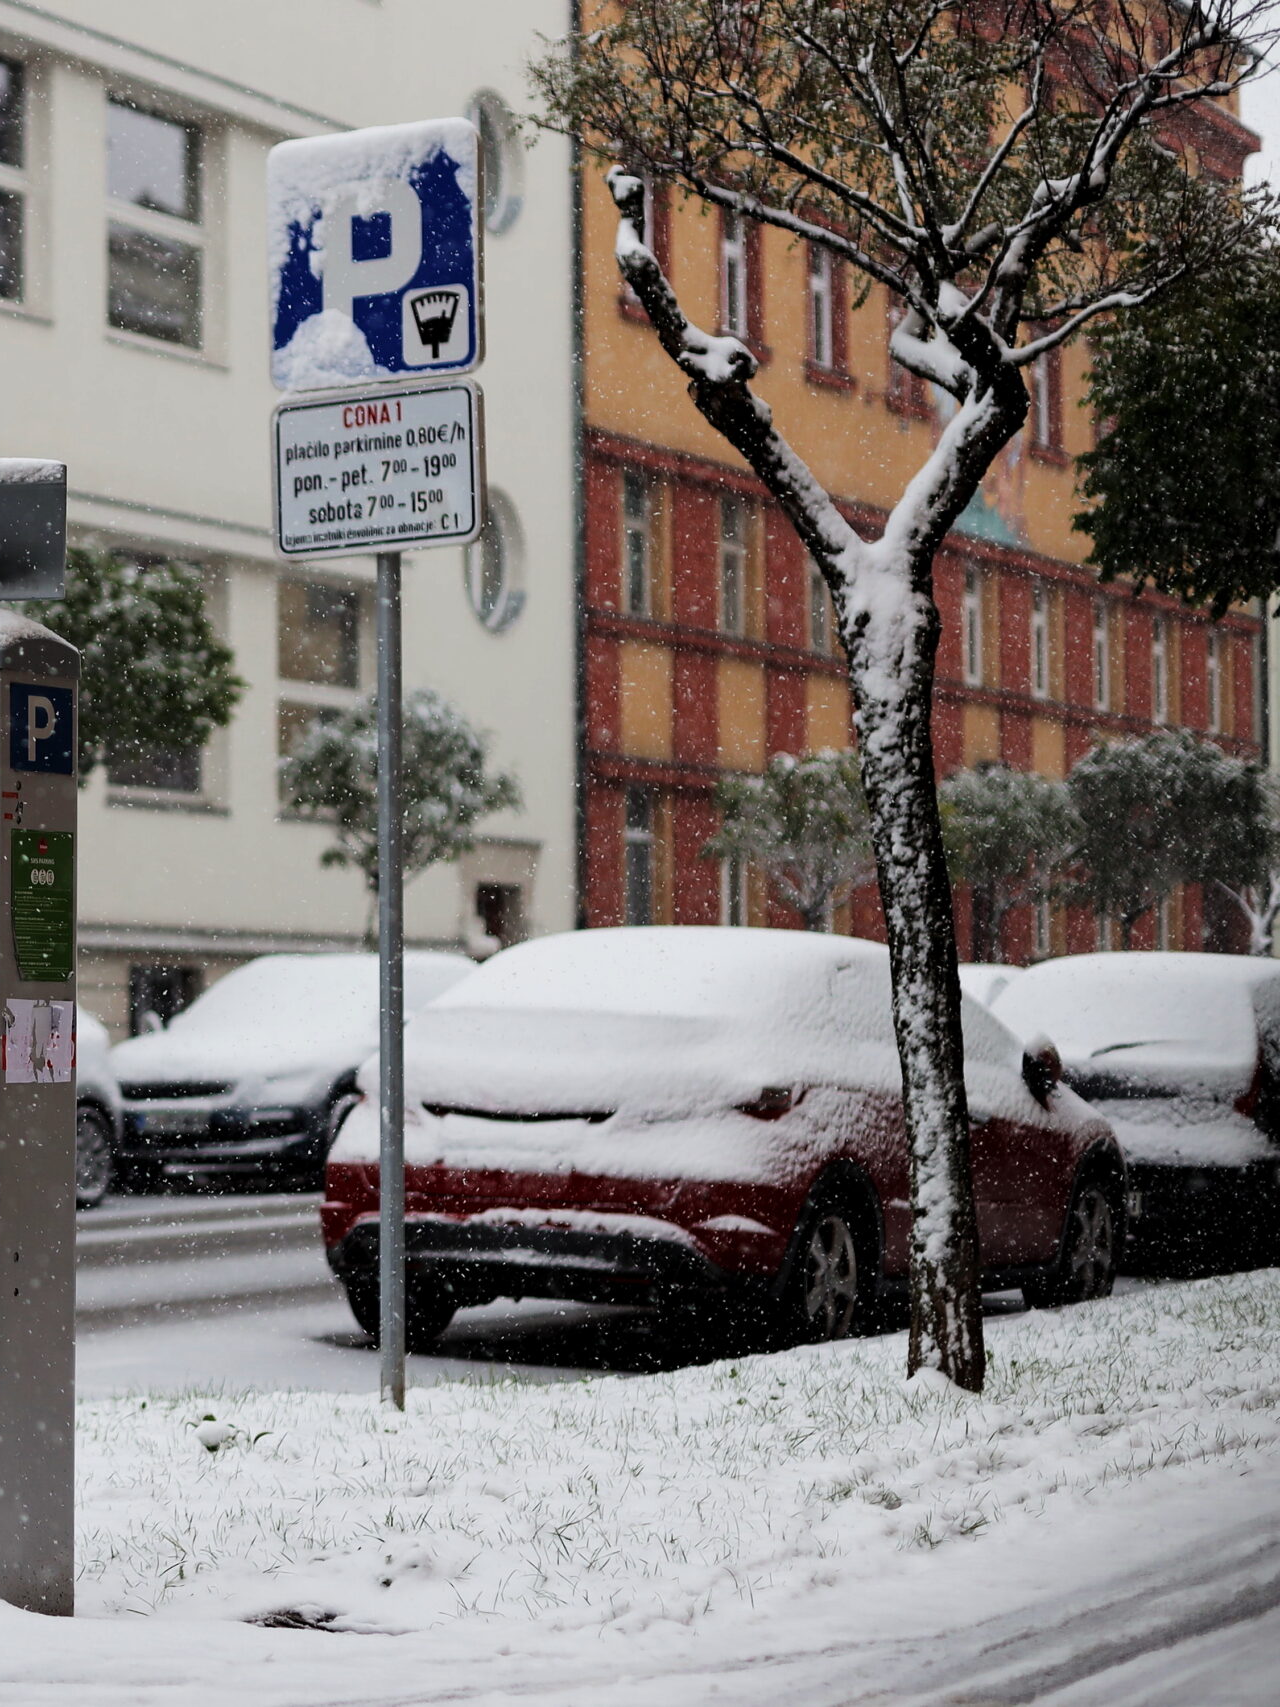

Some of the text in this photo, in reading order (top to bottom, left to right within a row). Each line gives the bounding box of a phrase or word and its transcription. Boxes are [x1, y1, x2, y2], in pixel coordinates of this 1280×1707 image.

[322, 178, 423, 318] P
[343, 401, 403, 428] CONA 1
[286, 421, 465, 465] plačilo parkirnine 0,80€/h
[342, 465, 374, 492] pet.
[309, 501, 362, 525] sobota
[441, 515, 450, 531] C
[28, 695, 56, 762] P
